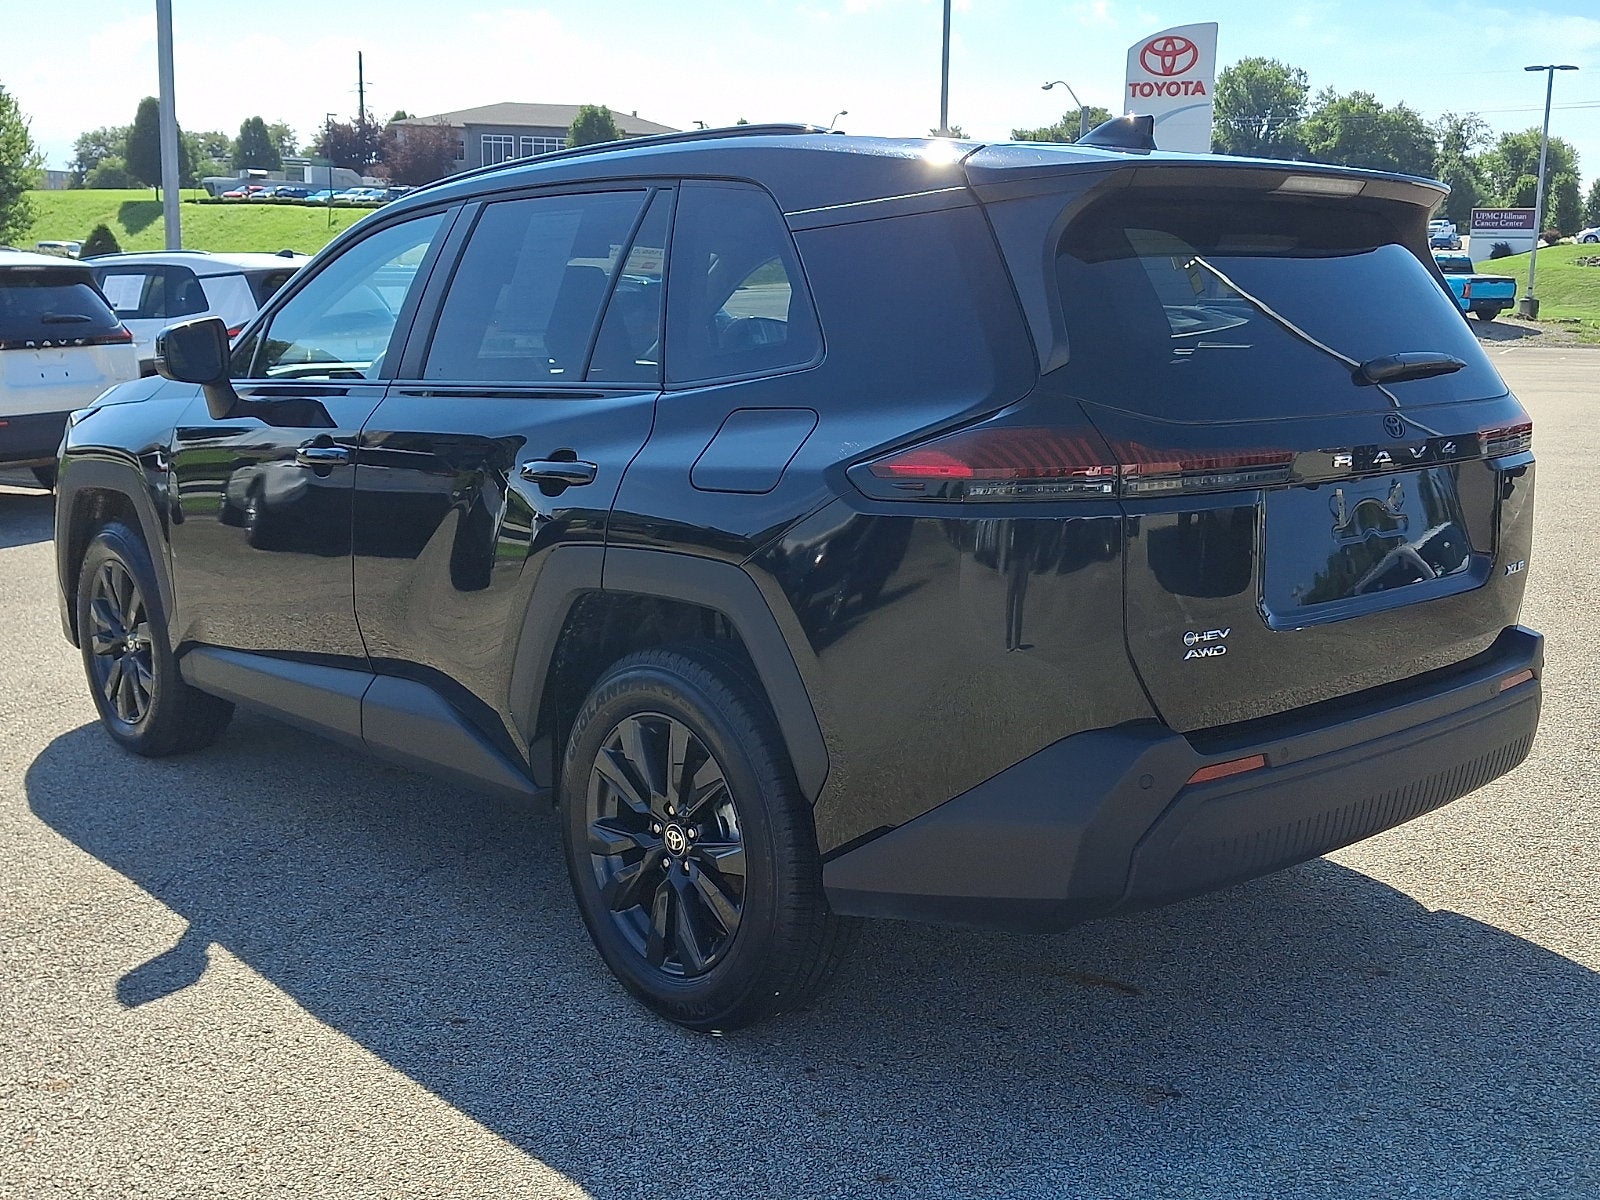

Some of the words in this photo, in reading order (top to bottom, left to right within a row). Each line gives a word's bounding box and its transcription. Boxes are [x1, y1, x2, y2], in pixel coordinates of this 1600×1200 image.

[1128, 80, 1206, 98] TOYOTA
[1474, 219, 1499, 227] Cancer
[1499, 219, 1524, 227] Center
[1475, 212, 1500, 220] UPMC
[1500, 211, 1527, 220] Hillman
[1332, 441, 1457, 468] RAV4
[1504, 560, 1525, 576] XLE
[1183, 645, 1227, 660] AWD
